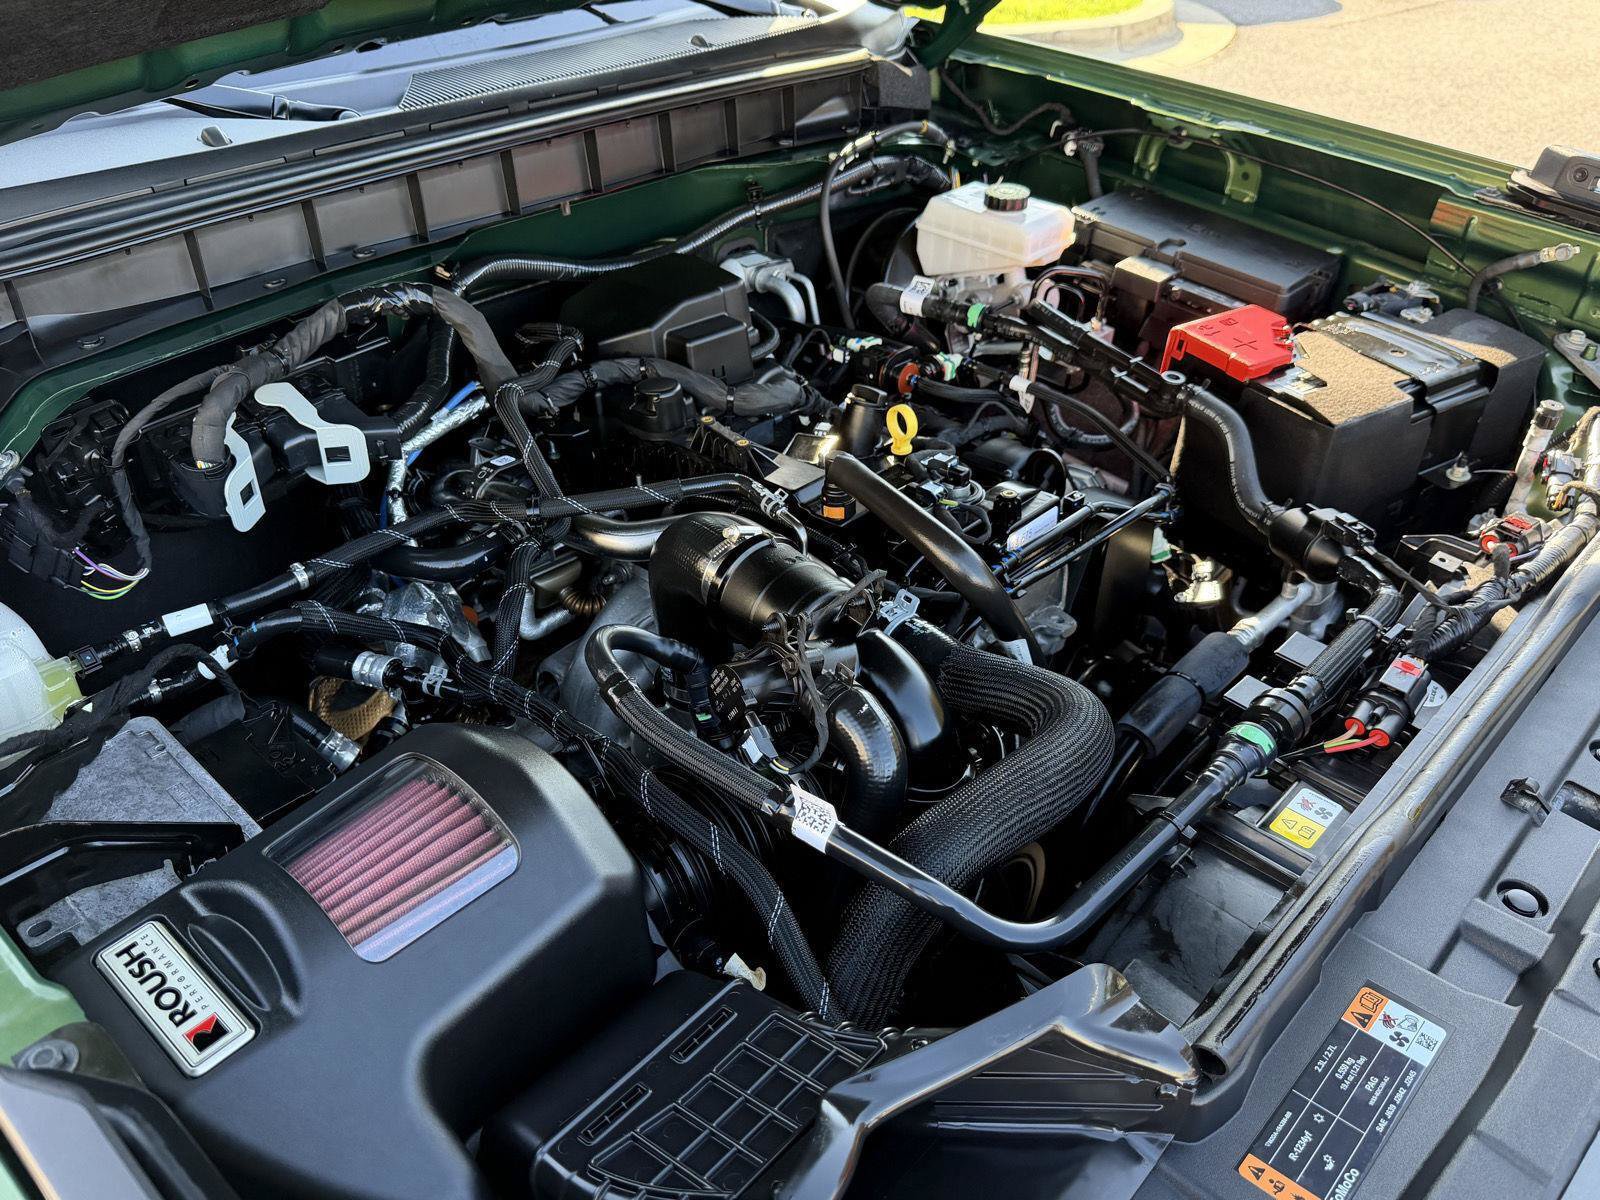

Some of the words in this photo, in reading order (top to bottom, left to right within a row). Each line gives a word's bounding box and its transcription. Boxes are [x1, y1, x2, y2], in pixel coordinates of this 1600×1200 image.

[114, 940, 198, 1028] ROUSH
[140, 933, 209, 1011] PERFORMANCE
[1314, 1060, 1328, 1073] 2.3L
[1324, 1044, 1338, 1058] 2.7L
[1343, 1056, 1356, 1066] kg
[1364, 1076, 1379, 1092] PAG
[1375, 1118, 1388, 1133] SAE
[1384, 1103, 1397, 1119] J639
[1288, 1129, 1313, 1162] R-1234yf
